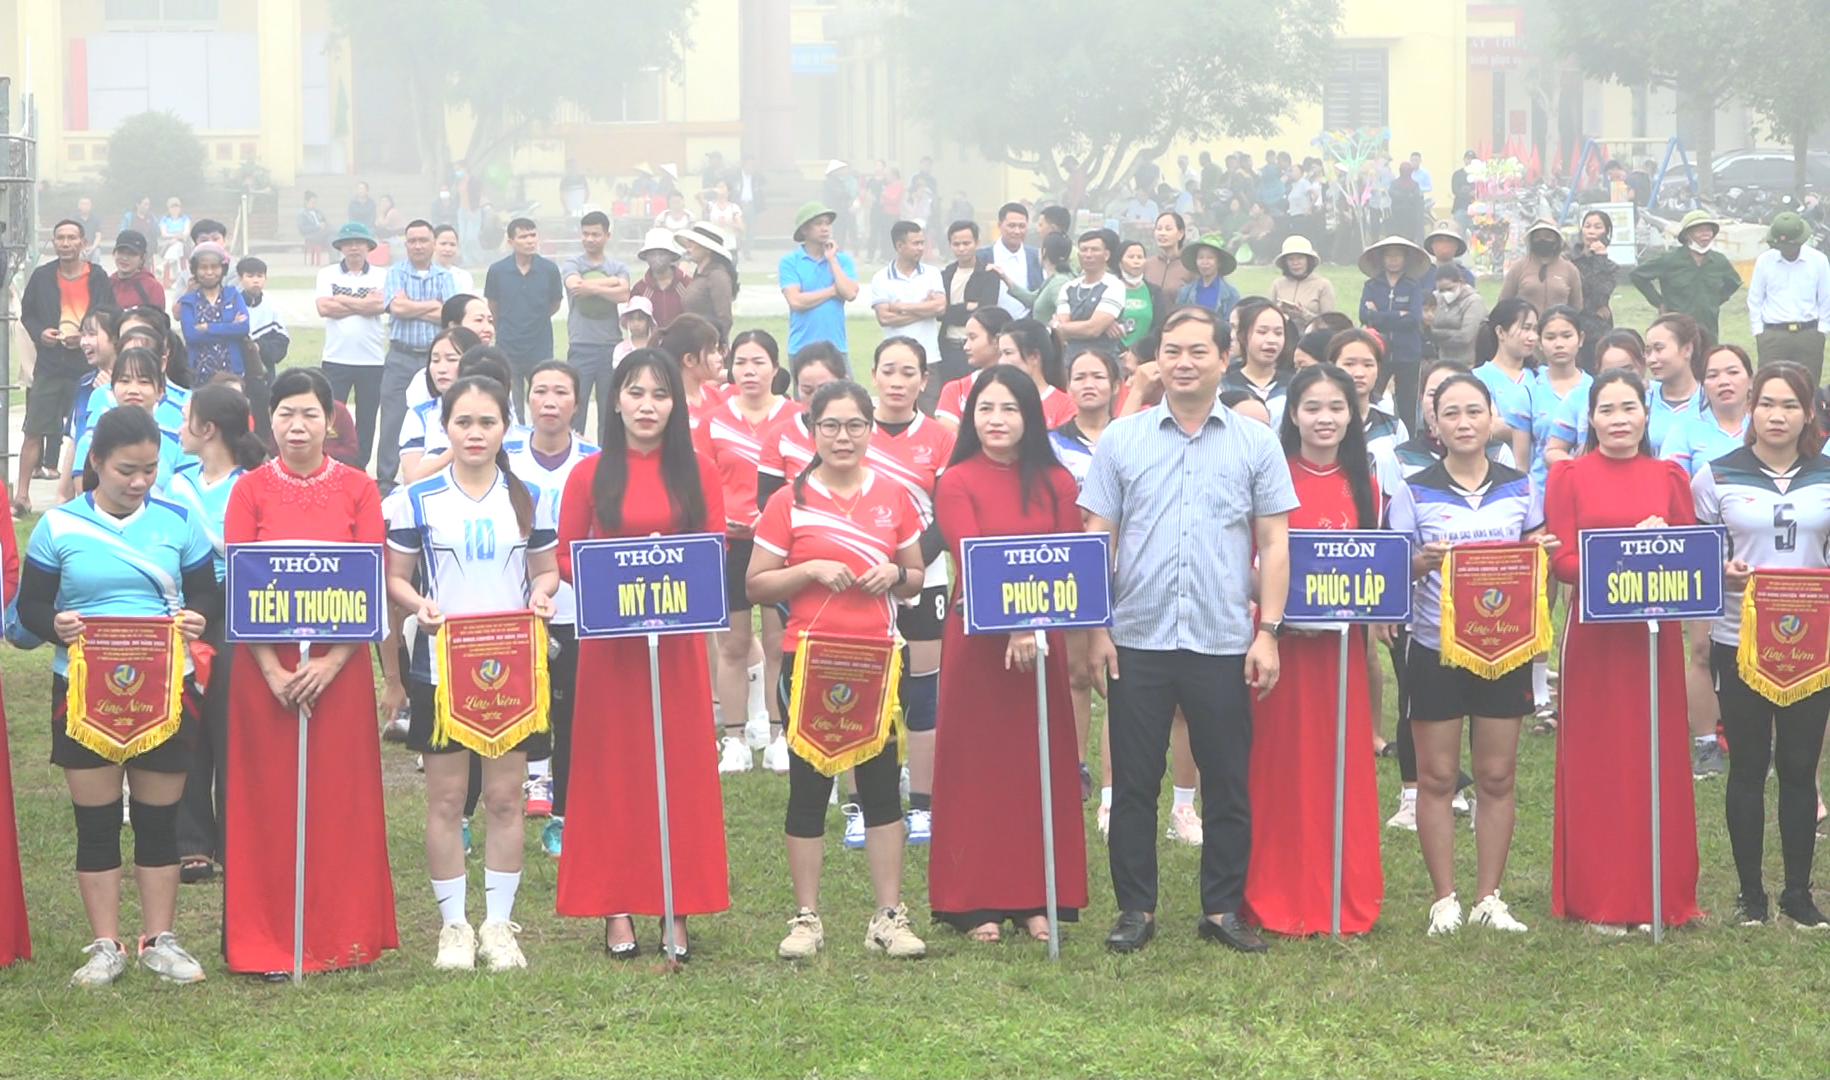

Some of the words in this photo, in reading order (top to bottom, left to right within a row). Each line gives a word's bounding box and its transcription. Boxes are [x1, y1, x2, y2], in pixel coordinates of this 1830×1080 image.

[463, 518, 495, 561] 10
[1314, 538, 1376, 557] THÔN
[1621, 534, 1685, 555] THÔN
[1774, 503, 1797, 552] 5
[269, 553, 340, 572] THÔN
[614, 544, 684, 566] THÔN
[1004, 544, 1070, 564] THÔN
[618, 577, 646, 616] MỸ
[651, 574, 687, 614] TÂN
[1002, 574, 1049, 614] PHÚC
[1053, 572, 1078, 618] ĐỘ
[1306, 568, 1350, 606] PHÚC
[1355, 568, 1385, 612] LẬP
[1607, 570, 1643, 604] SƠN
[1648, 564, 1688, 602] BÌNH
[1694, 570, 1702, 600] 1
[248, 579, 289, 623] TIẾN
[294, 587, 366, 631] THƯỢNG
[935, 594, 945, 620] 8
